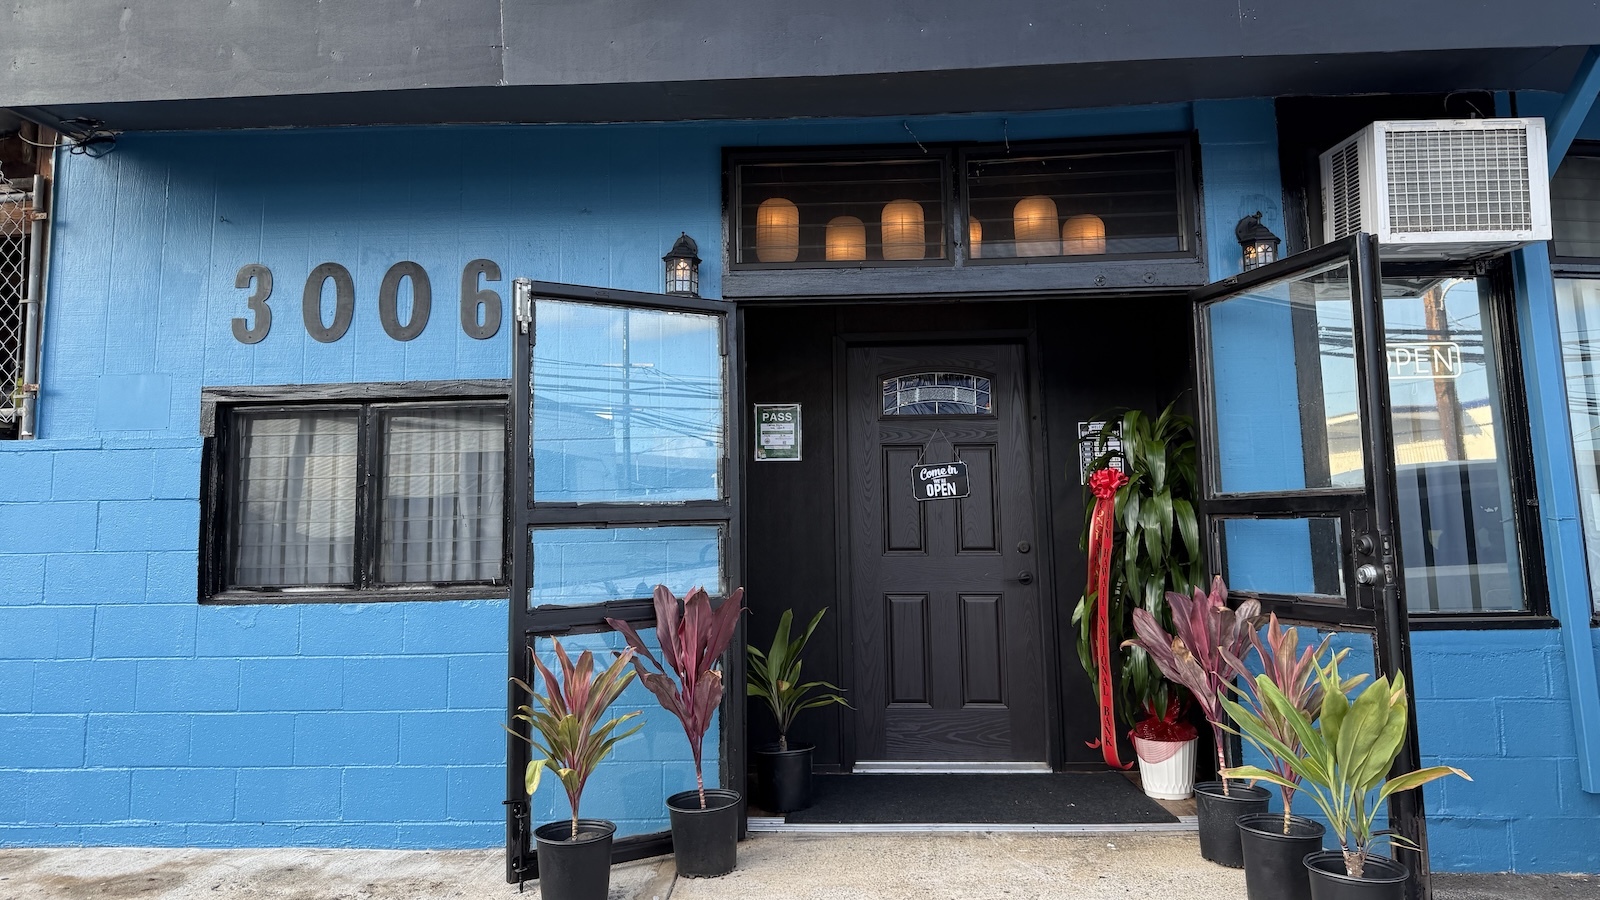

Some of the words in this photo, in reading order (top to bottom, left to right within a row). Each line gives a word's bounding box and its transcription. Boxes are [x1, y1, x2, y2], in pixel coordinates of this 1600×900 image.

[231, 258, 502, 345] 3006
[762, 412, 793, 422] PASS
[920, 468, 948, 481] Come
[926, 482, 957, 497] OPEN
[1100, 615, 1109, 696] NATIONAL
[1103, 705, 1113, 747] BANK
